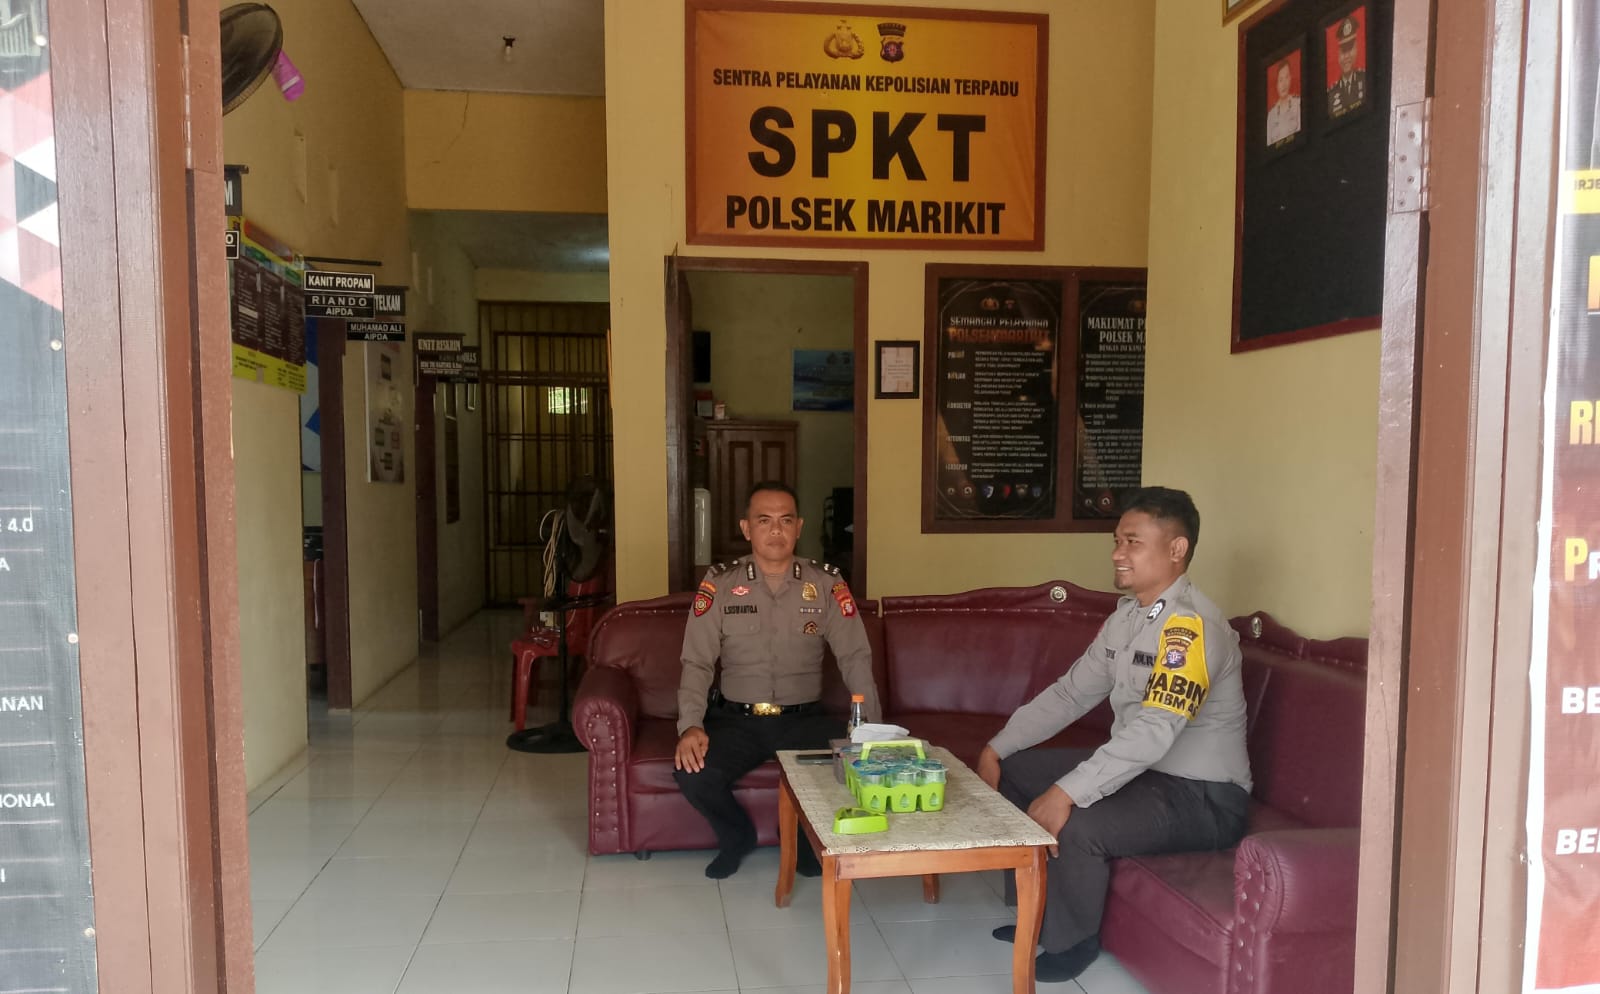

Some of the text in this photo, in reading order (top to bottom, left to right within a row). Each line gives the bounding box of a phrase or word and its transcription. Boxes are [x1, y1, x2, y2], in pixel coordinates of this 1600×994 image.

[713, 68, 1019, 97] SENTRA PELAYANAN KEPOLISIAN TERPADU
[748, 105, 986, 182] SPKT
[726, 195, 1006, 235] POLSEK MARIKIT
[308, 275, 371, 289] KANIT PROPAM
[311, 295, 367, 307] RIANDO
[325, 307, 354, 317] AIPDA
[350, 323, 402, 333] MUHAMAD ALI
[1087, 316, 1135, 330] MAKLUMAT
[364, 333, 389, 341] AIPDA
[1099, 330, 1134, 343] POLSEK
[8, 517, 34, 532] 4.0
[0, 695, 44, 712] NAN
